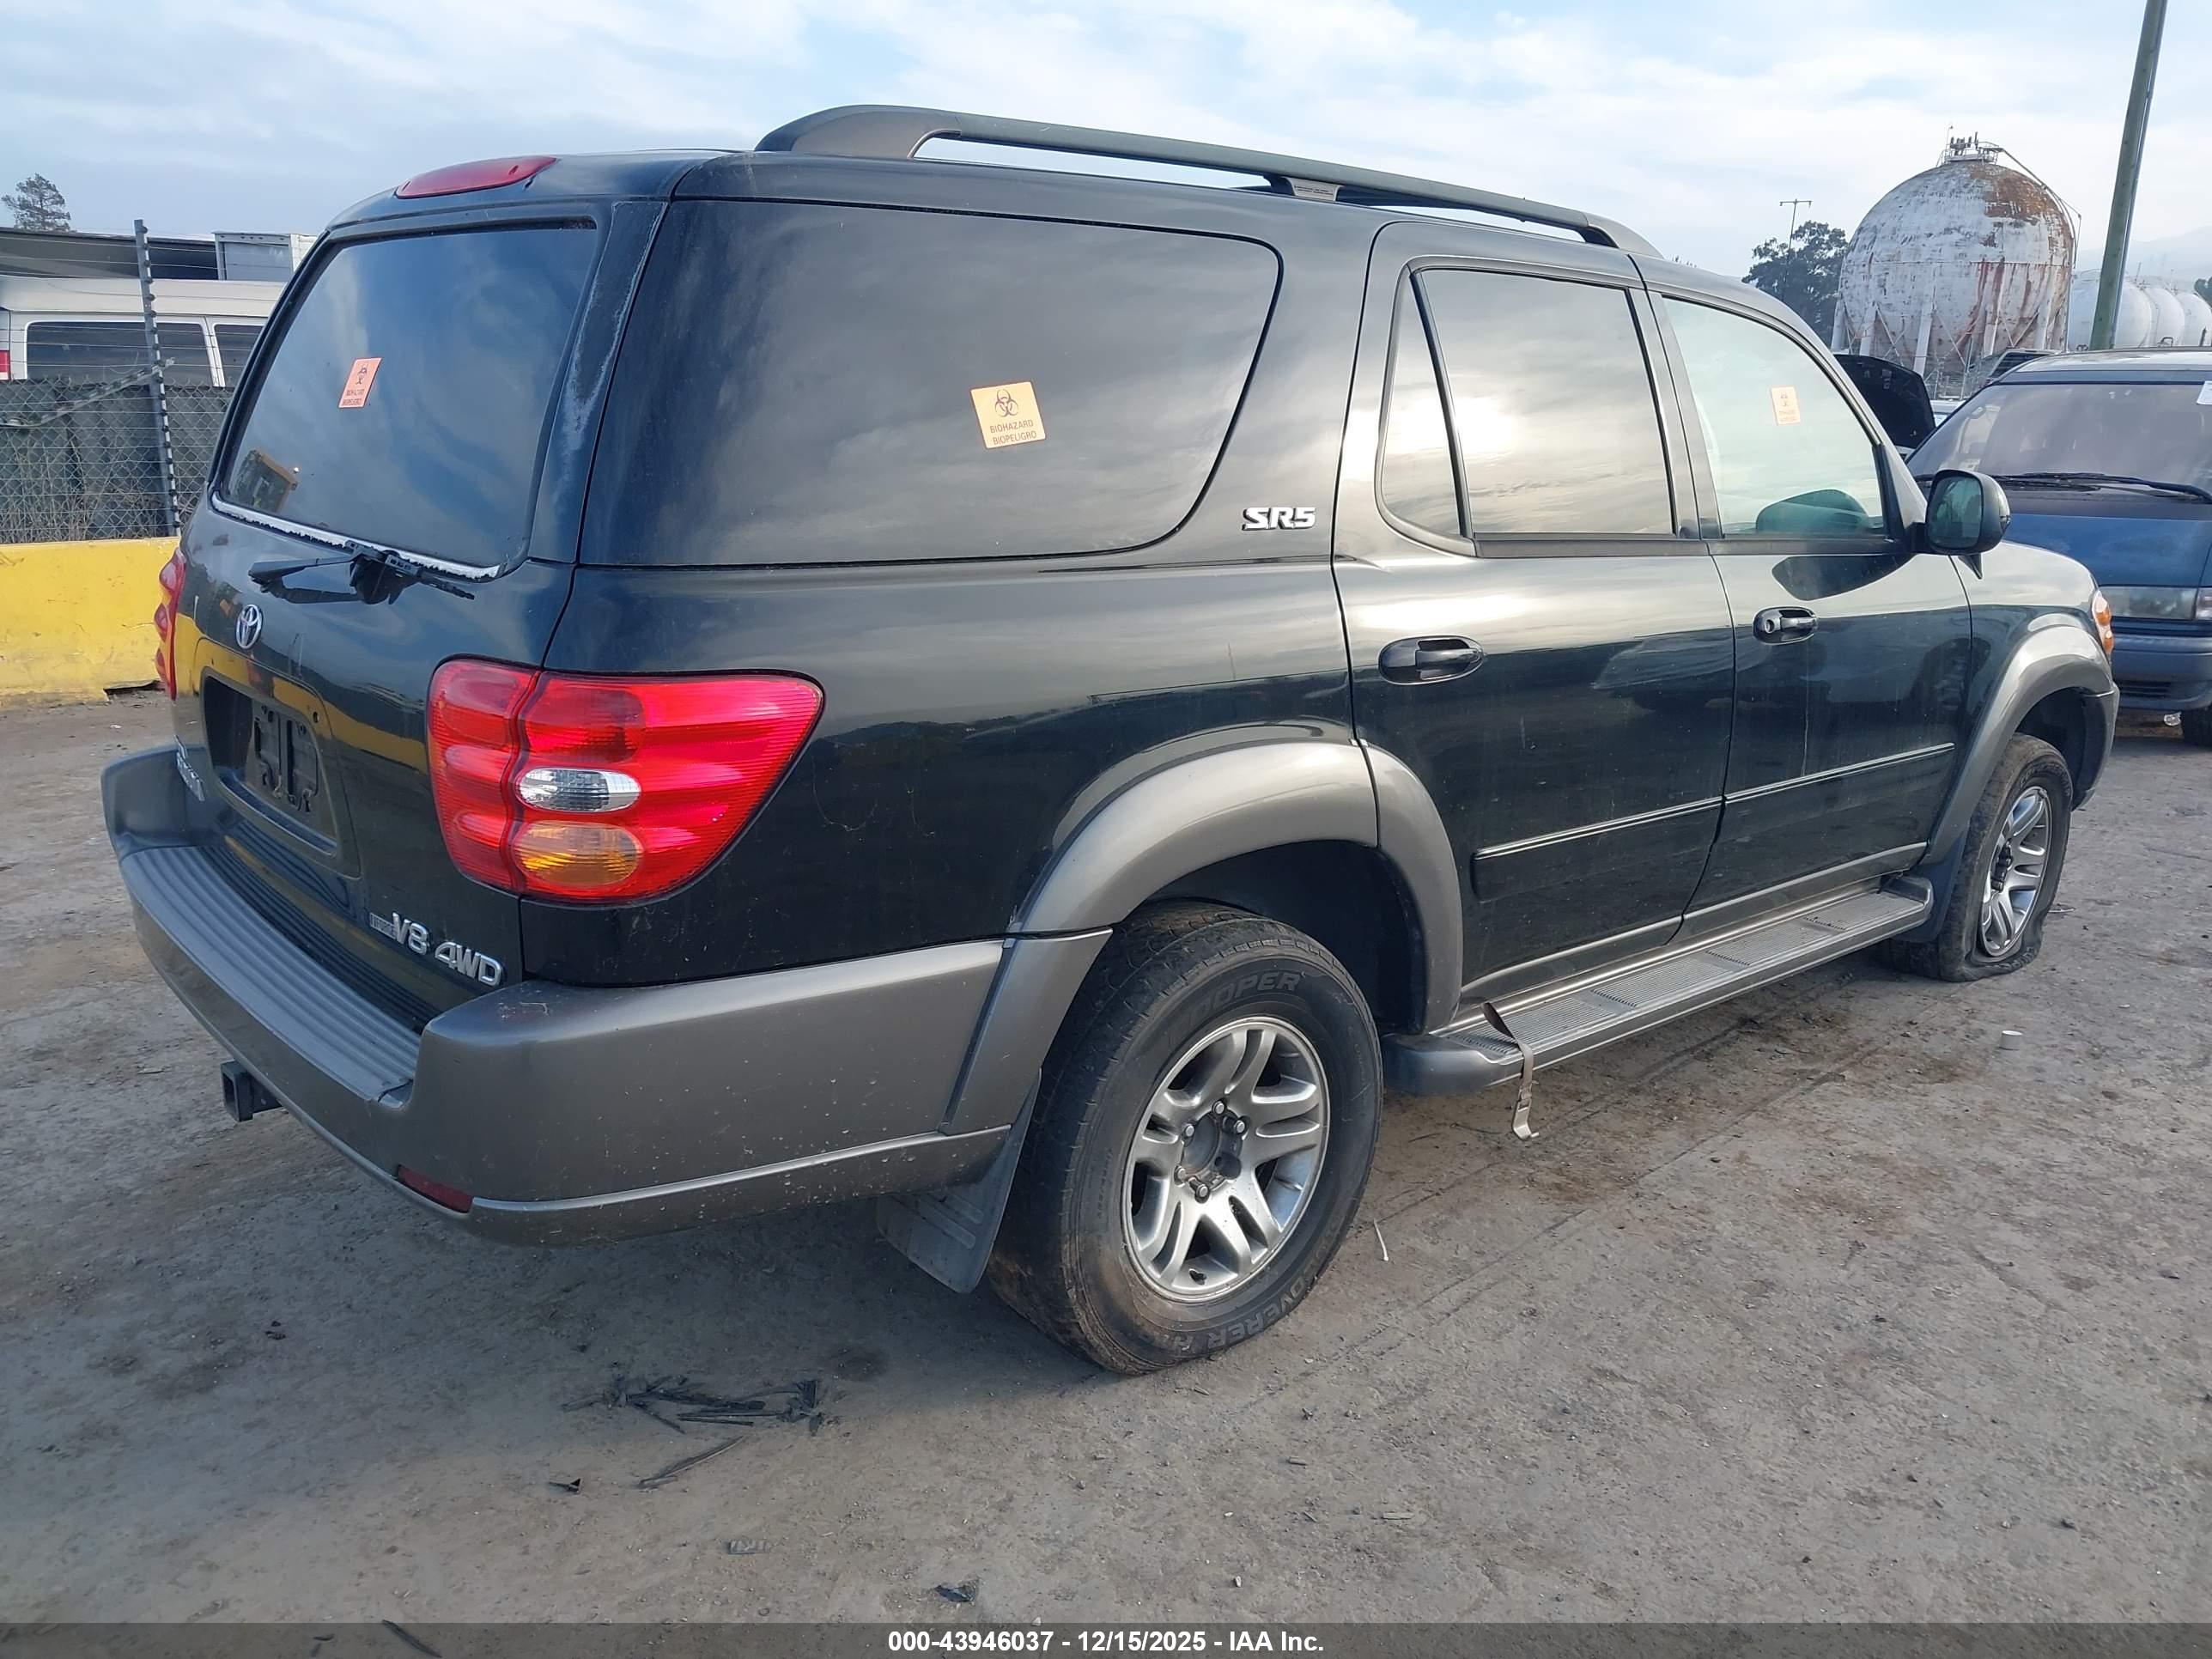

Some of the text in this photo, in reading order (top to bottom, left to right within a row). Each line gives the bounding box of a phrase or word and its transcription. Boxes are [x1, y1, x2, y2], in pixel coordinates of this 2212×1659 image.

[989, 419, 1034, 434] BIOHAZARD
[1242, 507, 1316, 531] SR5
[392, 912, 430, 956] V8
[434, 940, 504, 987] 4WD
